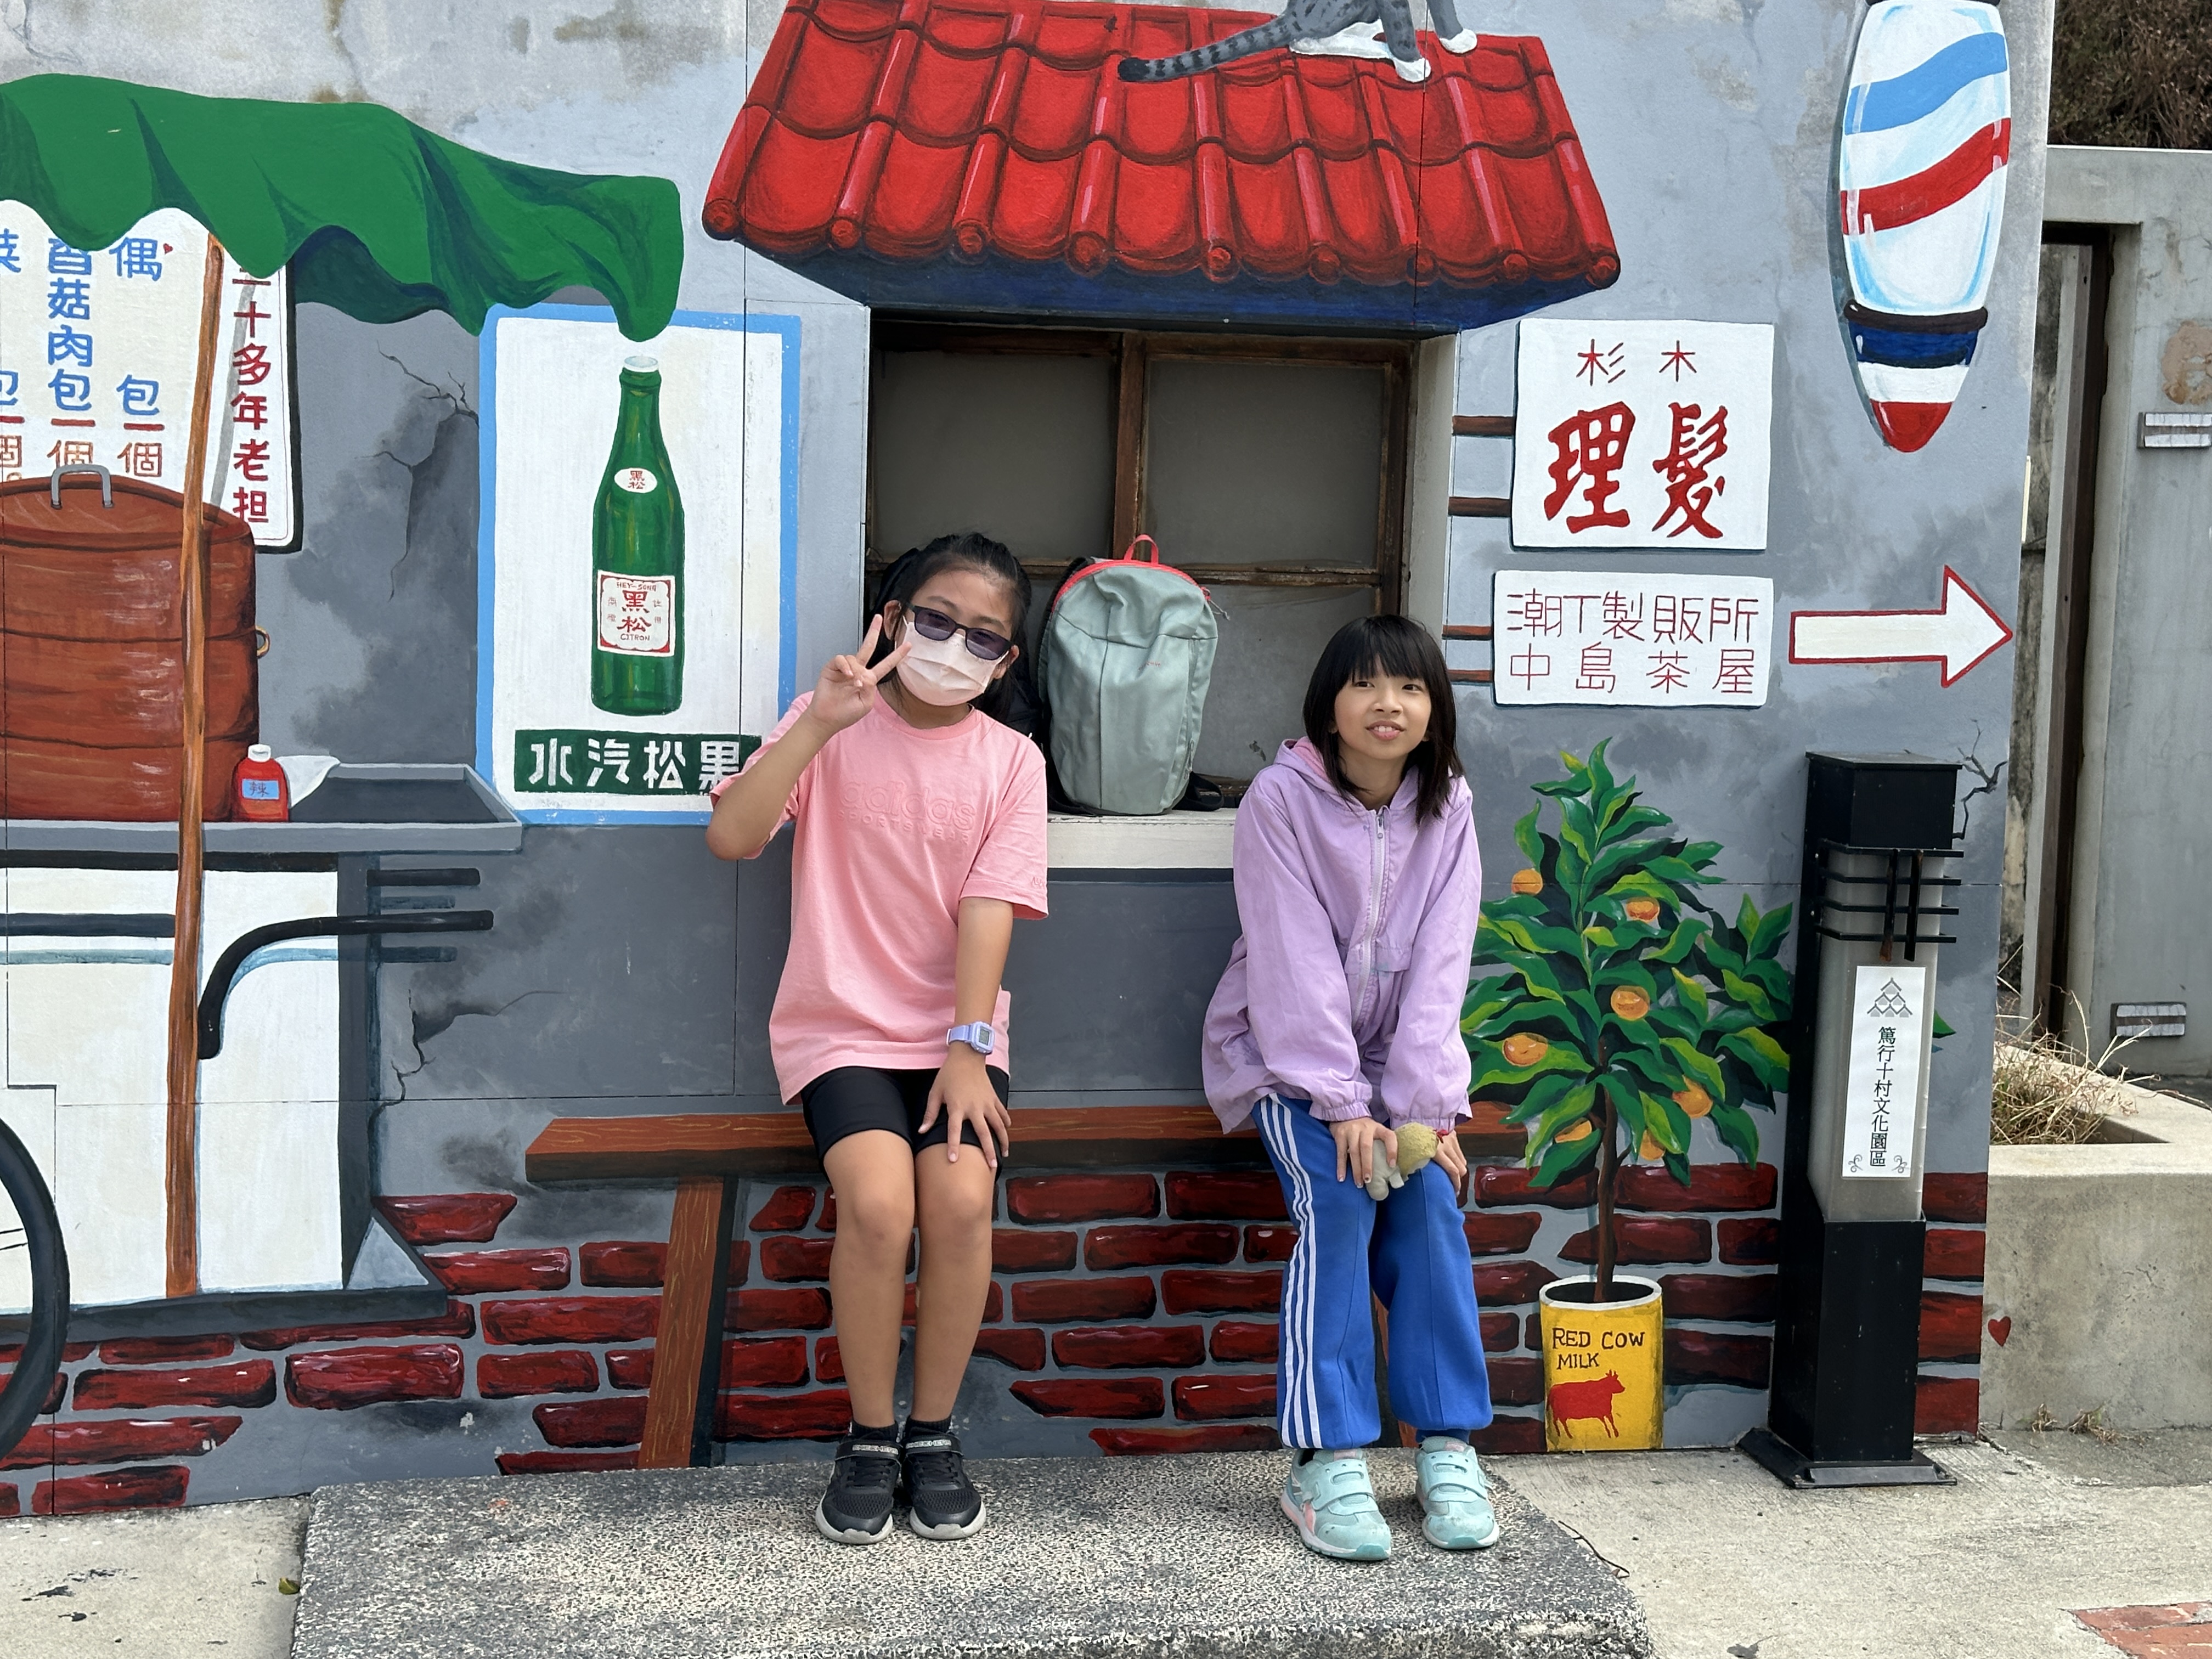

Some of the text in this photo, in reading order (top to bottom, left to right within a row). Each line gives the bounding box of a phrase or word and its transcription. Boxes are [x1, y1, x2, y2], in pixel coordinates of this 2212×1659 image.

[230, 268, 271, 523] 十多年老担
[617, 590, 652, 633] 黑松
[1510, 643, 1755, 695] 中島茶屋
[1870, 1026, 1897, 1167] 篤行十村文化園區
[1551, 1327, 1645, 1350] RED COW
[1556, 1352, 1600, 1369] MILK
